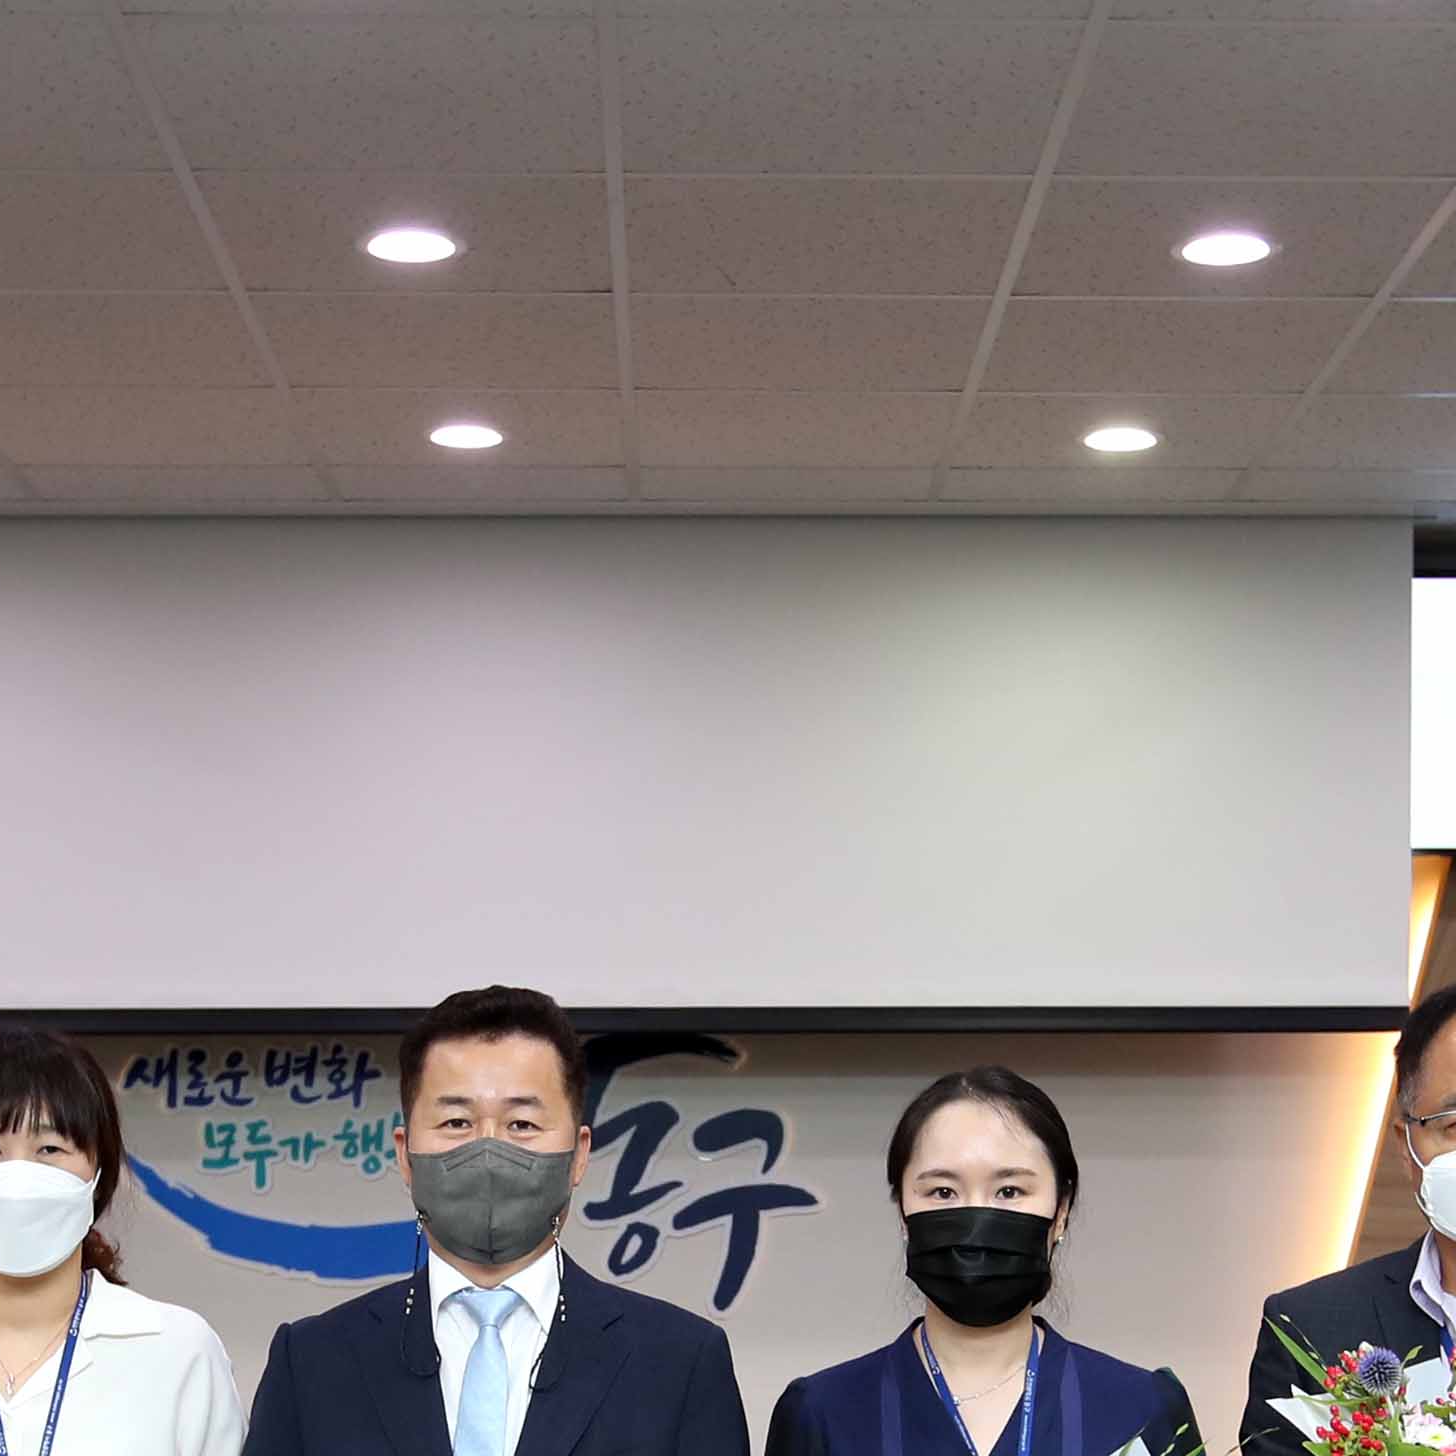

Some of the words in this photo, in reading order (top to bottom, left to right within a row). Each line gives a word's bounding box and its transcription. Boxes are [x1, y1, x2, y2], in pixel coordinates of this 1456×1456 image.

[123, 1048, 255, 1110] 새로운
[263, 1043, 382, 1109] 변화
[200, 1119, 327, 1189] 모두가
[333, 1111, 404, 1175] 행
